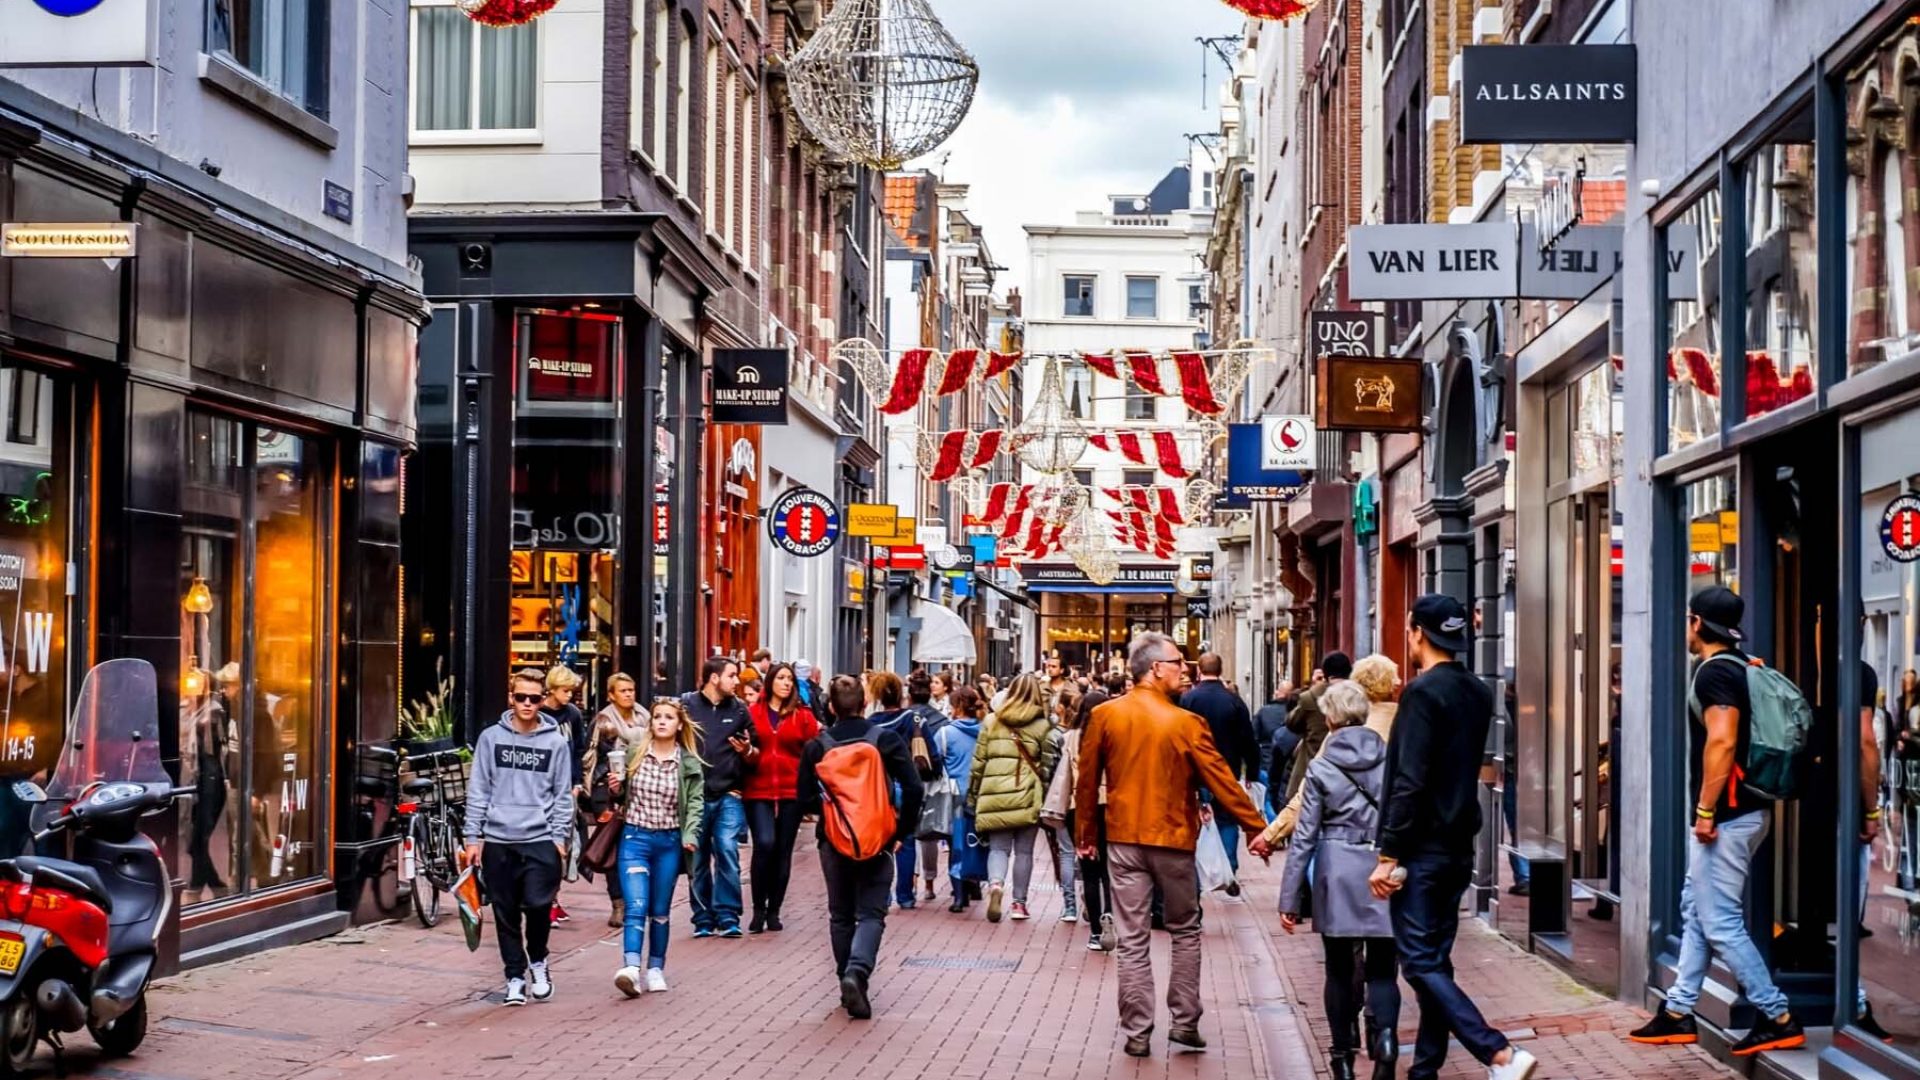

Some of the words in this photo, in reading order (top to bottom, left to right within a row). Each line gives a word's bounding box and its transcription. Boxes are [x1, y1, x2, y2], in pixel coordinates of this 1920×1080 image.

[1476, 83, 1625, 100] ALLSAINTS
[1368, 249, 1424, 273] VAN
[1438, 249, 1500, 272] LIER
[1317, 320, 1368, 342] UNO
[716, 389, 751, 401] MAKE-UP
[751, 389, 780, 401] STUDIO
[1232, 486, 1267, 494] STATE
[781, 494, 835, 517] SOUVENIRS
[782, 535, 831, 554] TOBACCO
[1037, 570, 1083, 578] AMSTERDAM
[7, 735, 35, 762] 14-15
